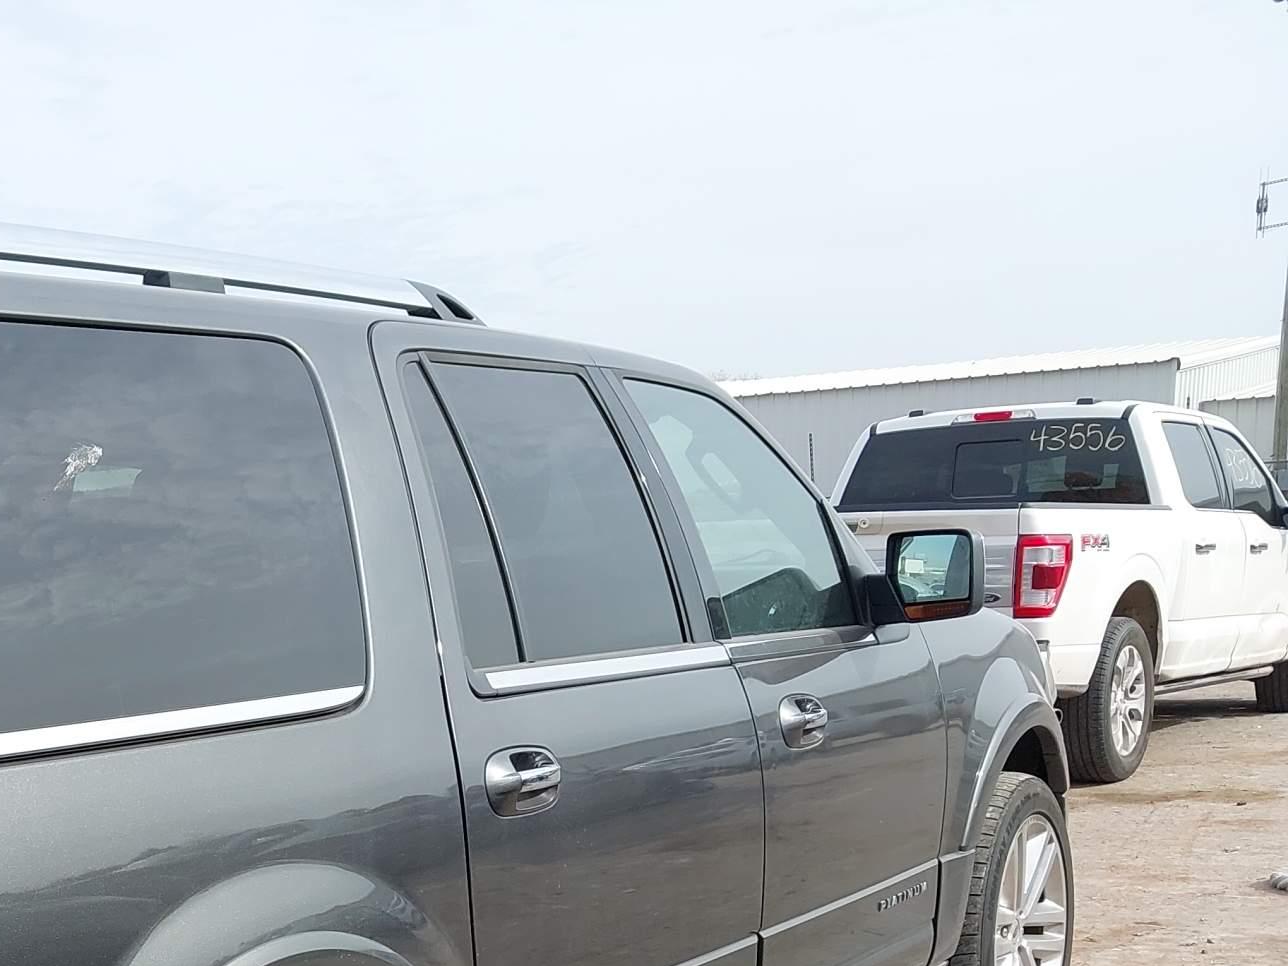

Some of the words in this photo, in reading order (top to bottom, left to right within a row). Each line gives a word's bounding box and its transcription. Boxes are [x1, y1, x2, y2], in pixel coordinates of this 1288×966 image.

[1030, 422, 1127, 452] 43556
[1081, 533, 1111, 552] FX4
[878, 881, 928, 912] PLATINUM
